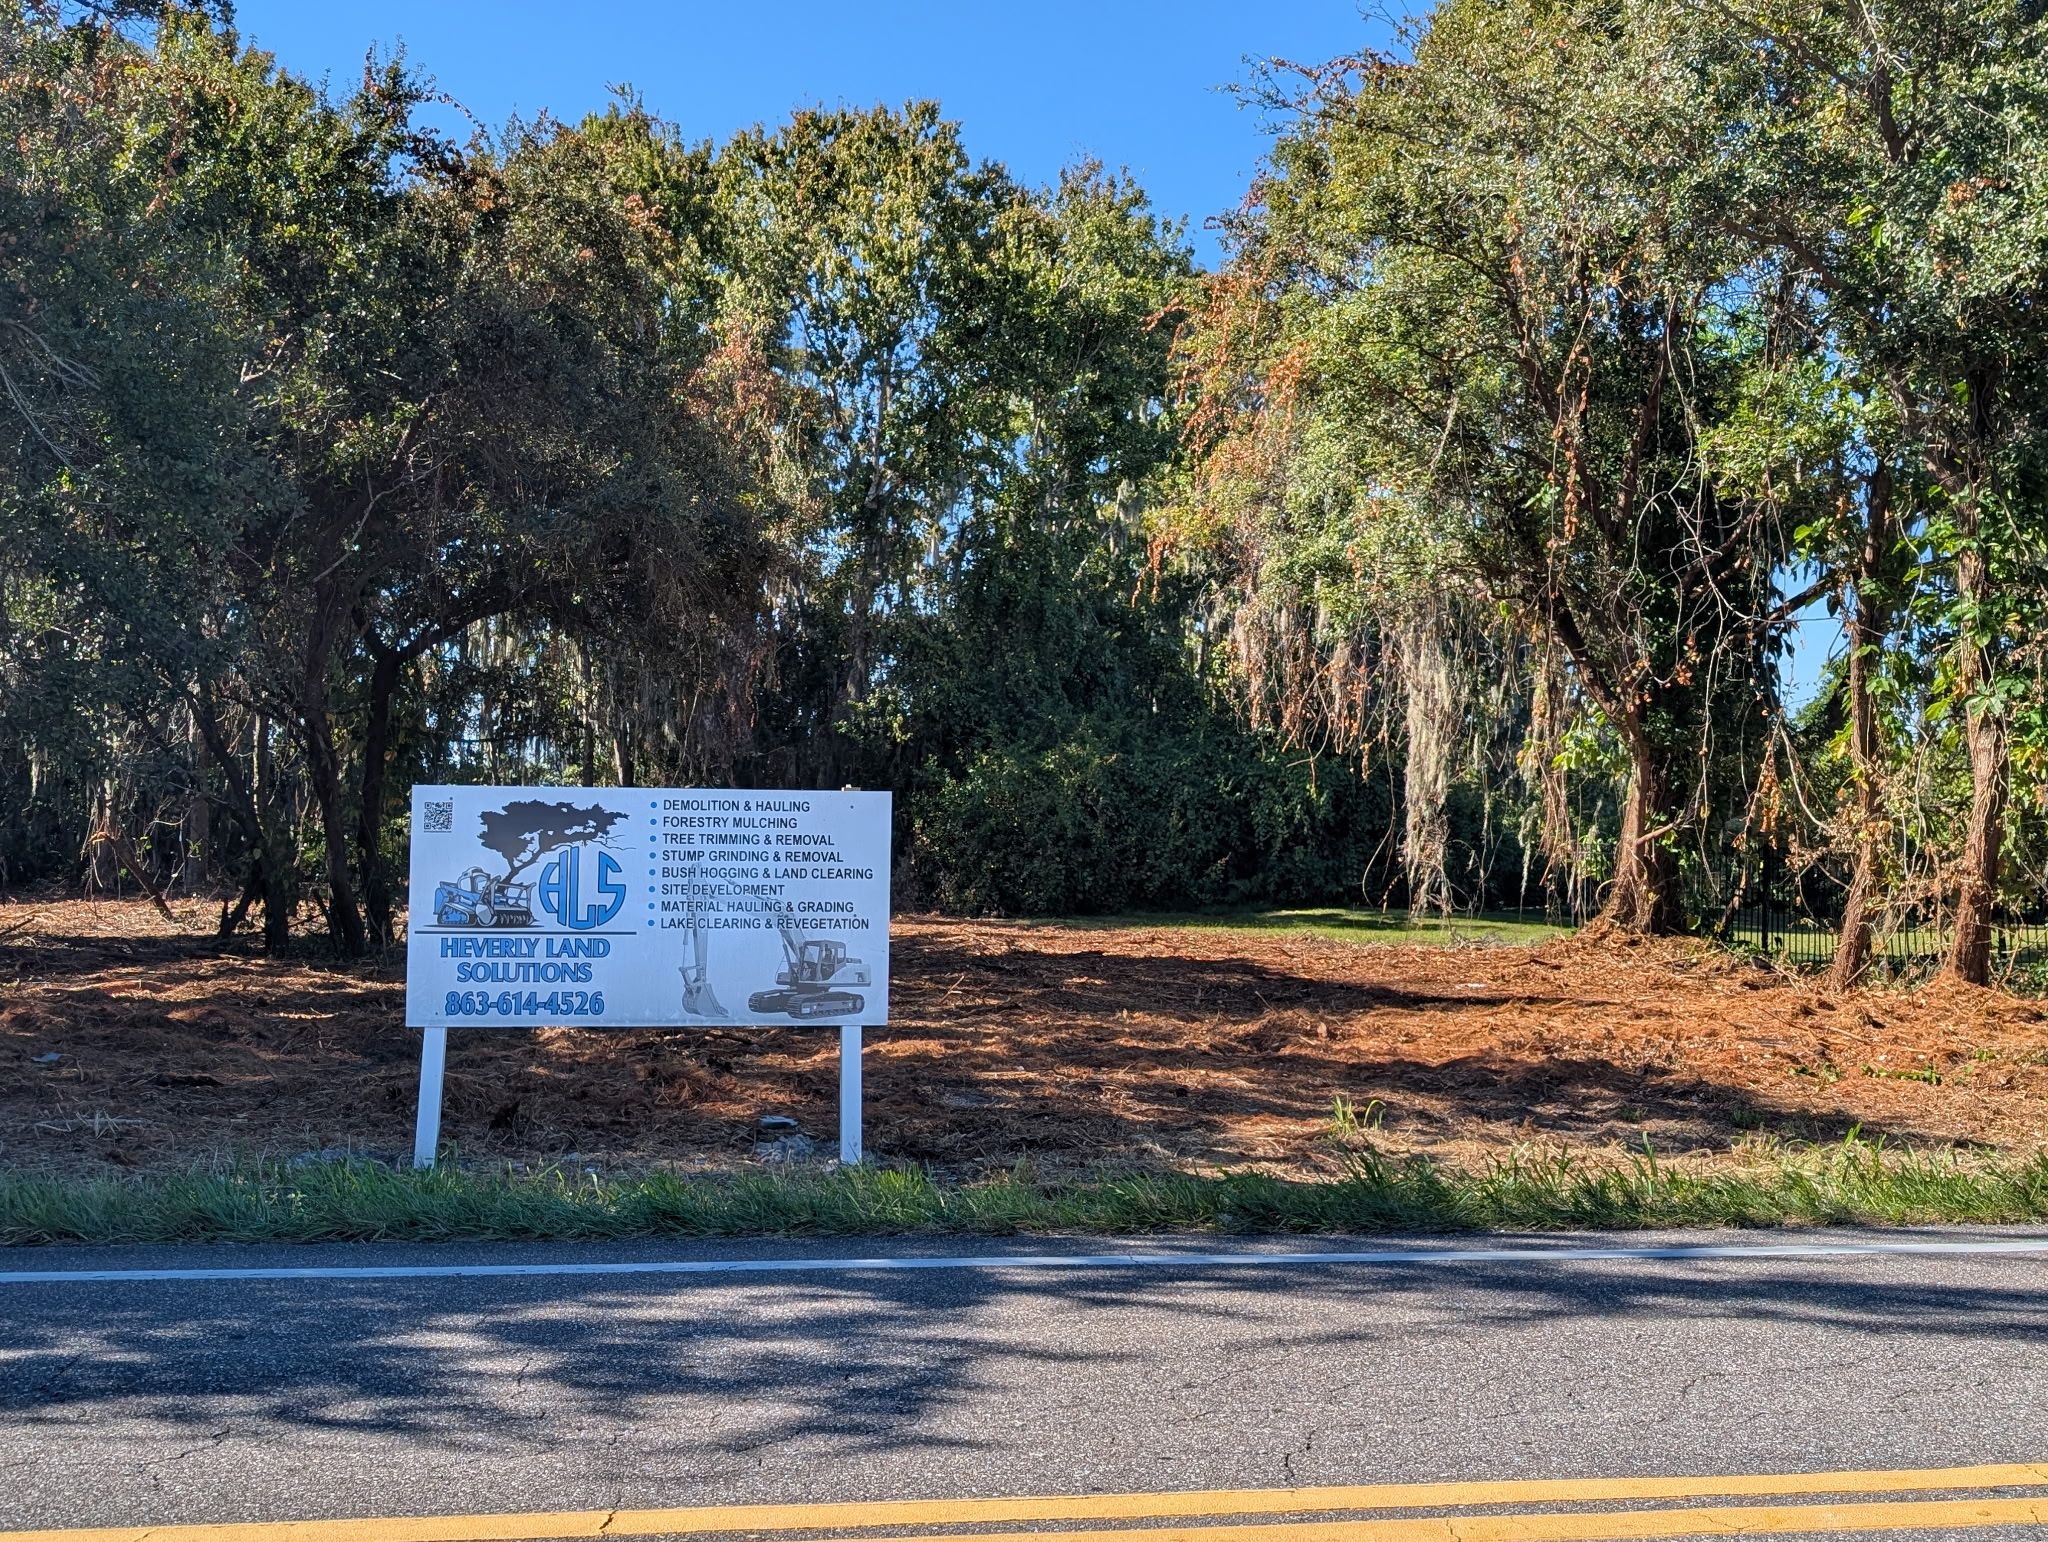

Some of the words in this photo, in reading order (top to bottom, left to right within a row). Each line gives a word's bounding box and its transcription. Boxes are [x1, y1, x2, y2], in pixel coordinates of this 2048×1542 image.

[663, 800, 740, 811] DEMOLITION
[743, 800, 752, 811] &
[755, 801, 810, 812] HAULING
[663, 817, 729, 828] FORESTRY
[732, 817, 798, 829] MULCHING
[663, 834, 695, 845] TREE
[698, 834, 760, 845] TRIMMING
[764, 834, 772, 845] &
[776, 834, 835, 846] REMOVAL
[662, 850, 704, 862] STUMP
[708, 851, 769, 862] GRINDING
[773, 851, 782, 862] &
[785, 851, 844, 863] REMOVAL
[661, 867, 696, 879] BUSH
[700, 867, 759, 879] HOGGING
[762, 868, 771, 879] &
[774, 868, 808, 879] LAND
[811, 868, 873, 880] CLEARING
[661, 884, 689, 896] SITE
[692, 884, 785, 896] DEVELOPMENT
[661, 901, 723, 912] MATERIAL
[727, 901, 782, 913] HAULING
[786, 901, 794, 913] &
[797, 901, 854, 913] GRADING
[660, 918, 693, 929] LAKE
[697, 918, 761, 929] CLEARING
[764, 918, 773, 929] &
[777, 918, 869, 930] REVEGETATION
[440, 938, 540, 958] HEVERLY
[546, 938, 611, 958] LAND
[456, 962, 593, 983] SOLUTIONS
[444, 991, 605, 1016] 863-614-4526
